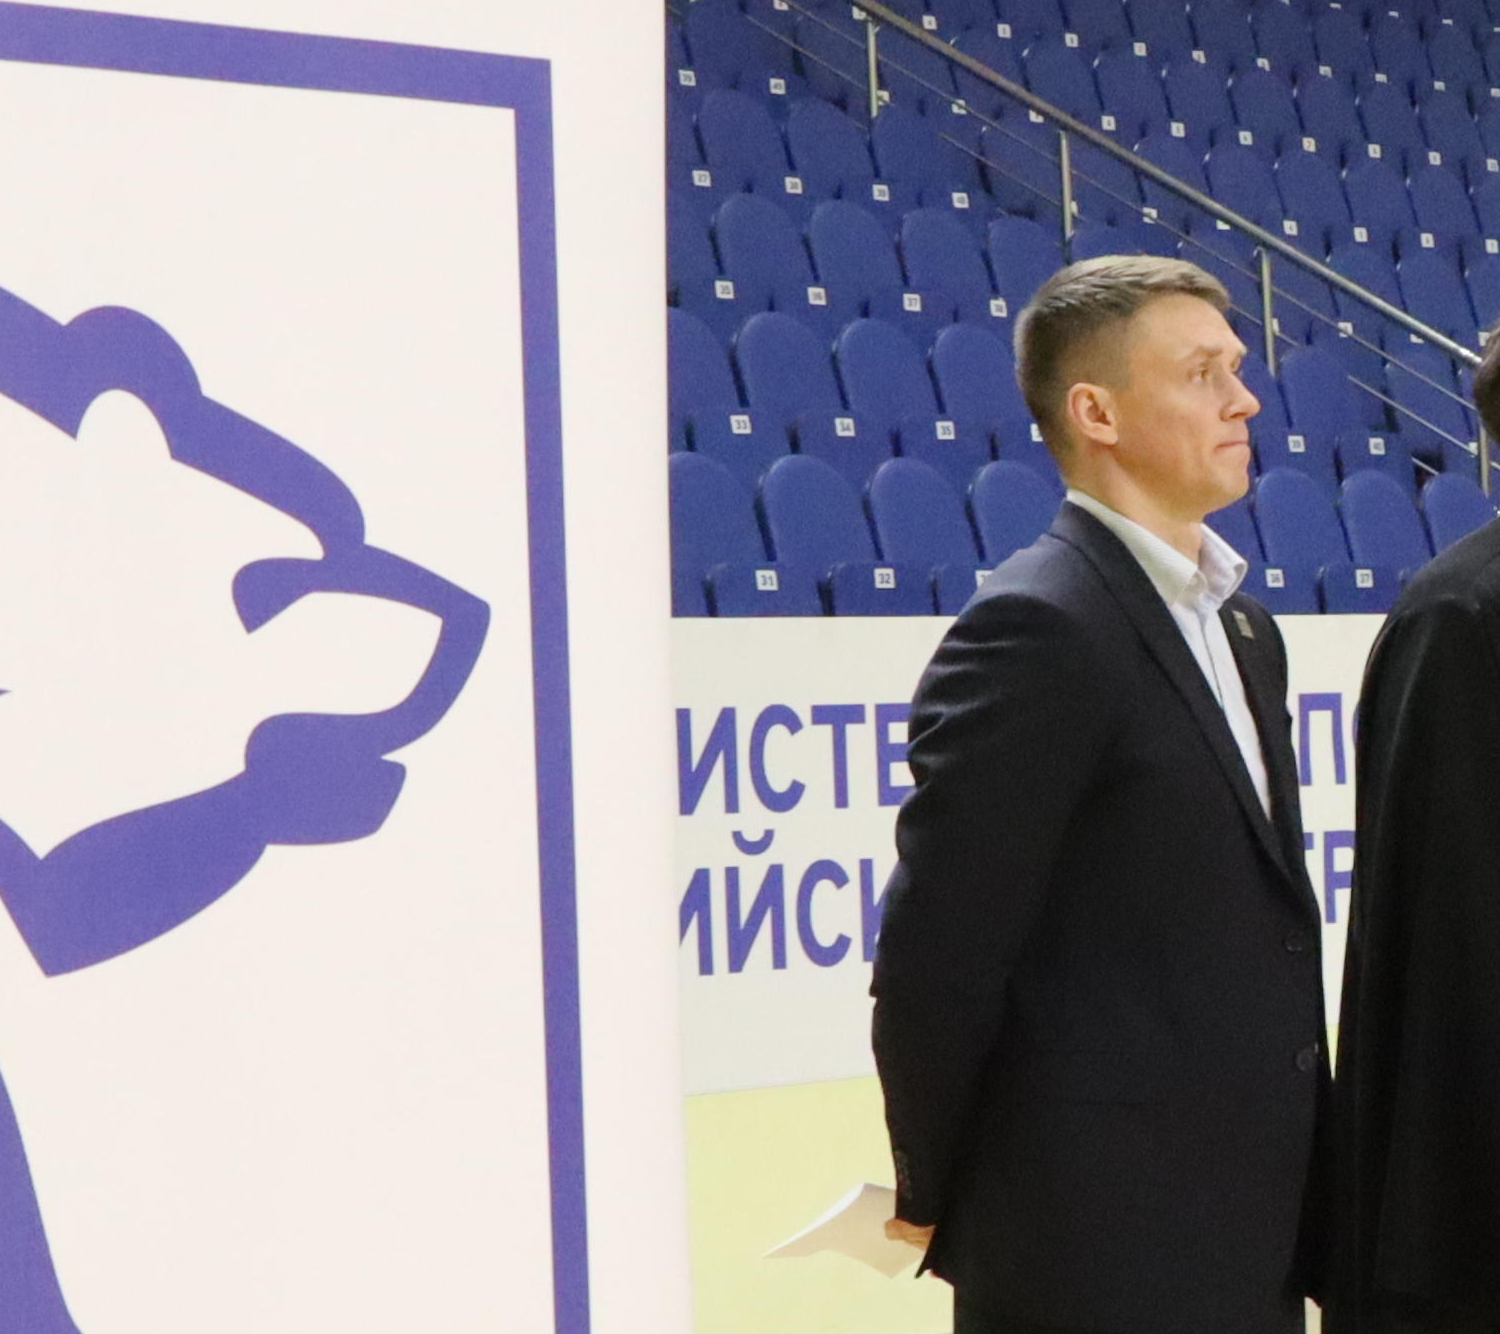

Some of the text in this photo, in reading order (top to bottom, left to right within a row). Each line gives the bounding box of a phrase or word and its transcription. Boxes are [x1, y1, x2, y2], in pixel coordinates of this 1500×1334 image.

[720, 285, 732, 296] 35
[907, 297, 918, 307] 37
[735, 419, 748, 431] 33
[840, 421, 852, 433] 34
[941, 425, 952, 436] 35
[761, 574, 774, 587] 31
[879, 573, 891, 585] 32
[1270, 573, 1281, 584] 36
[1360, 573, 1370, 584] 37
